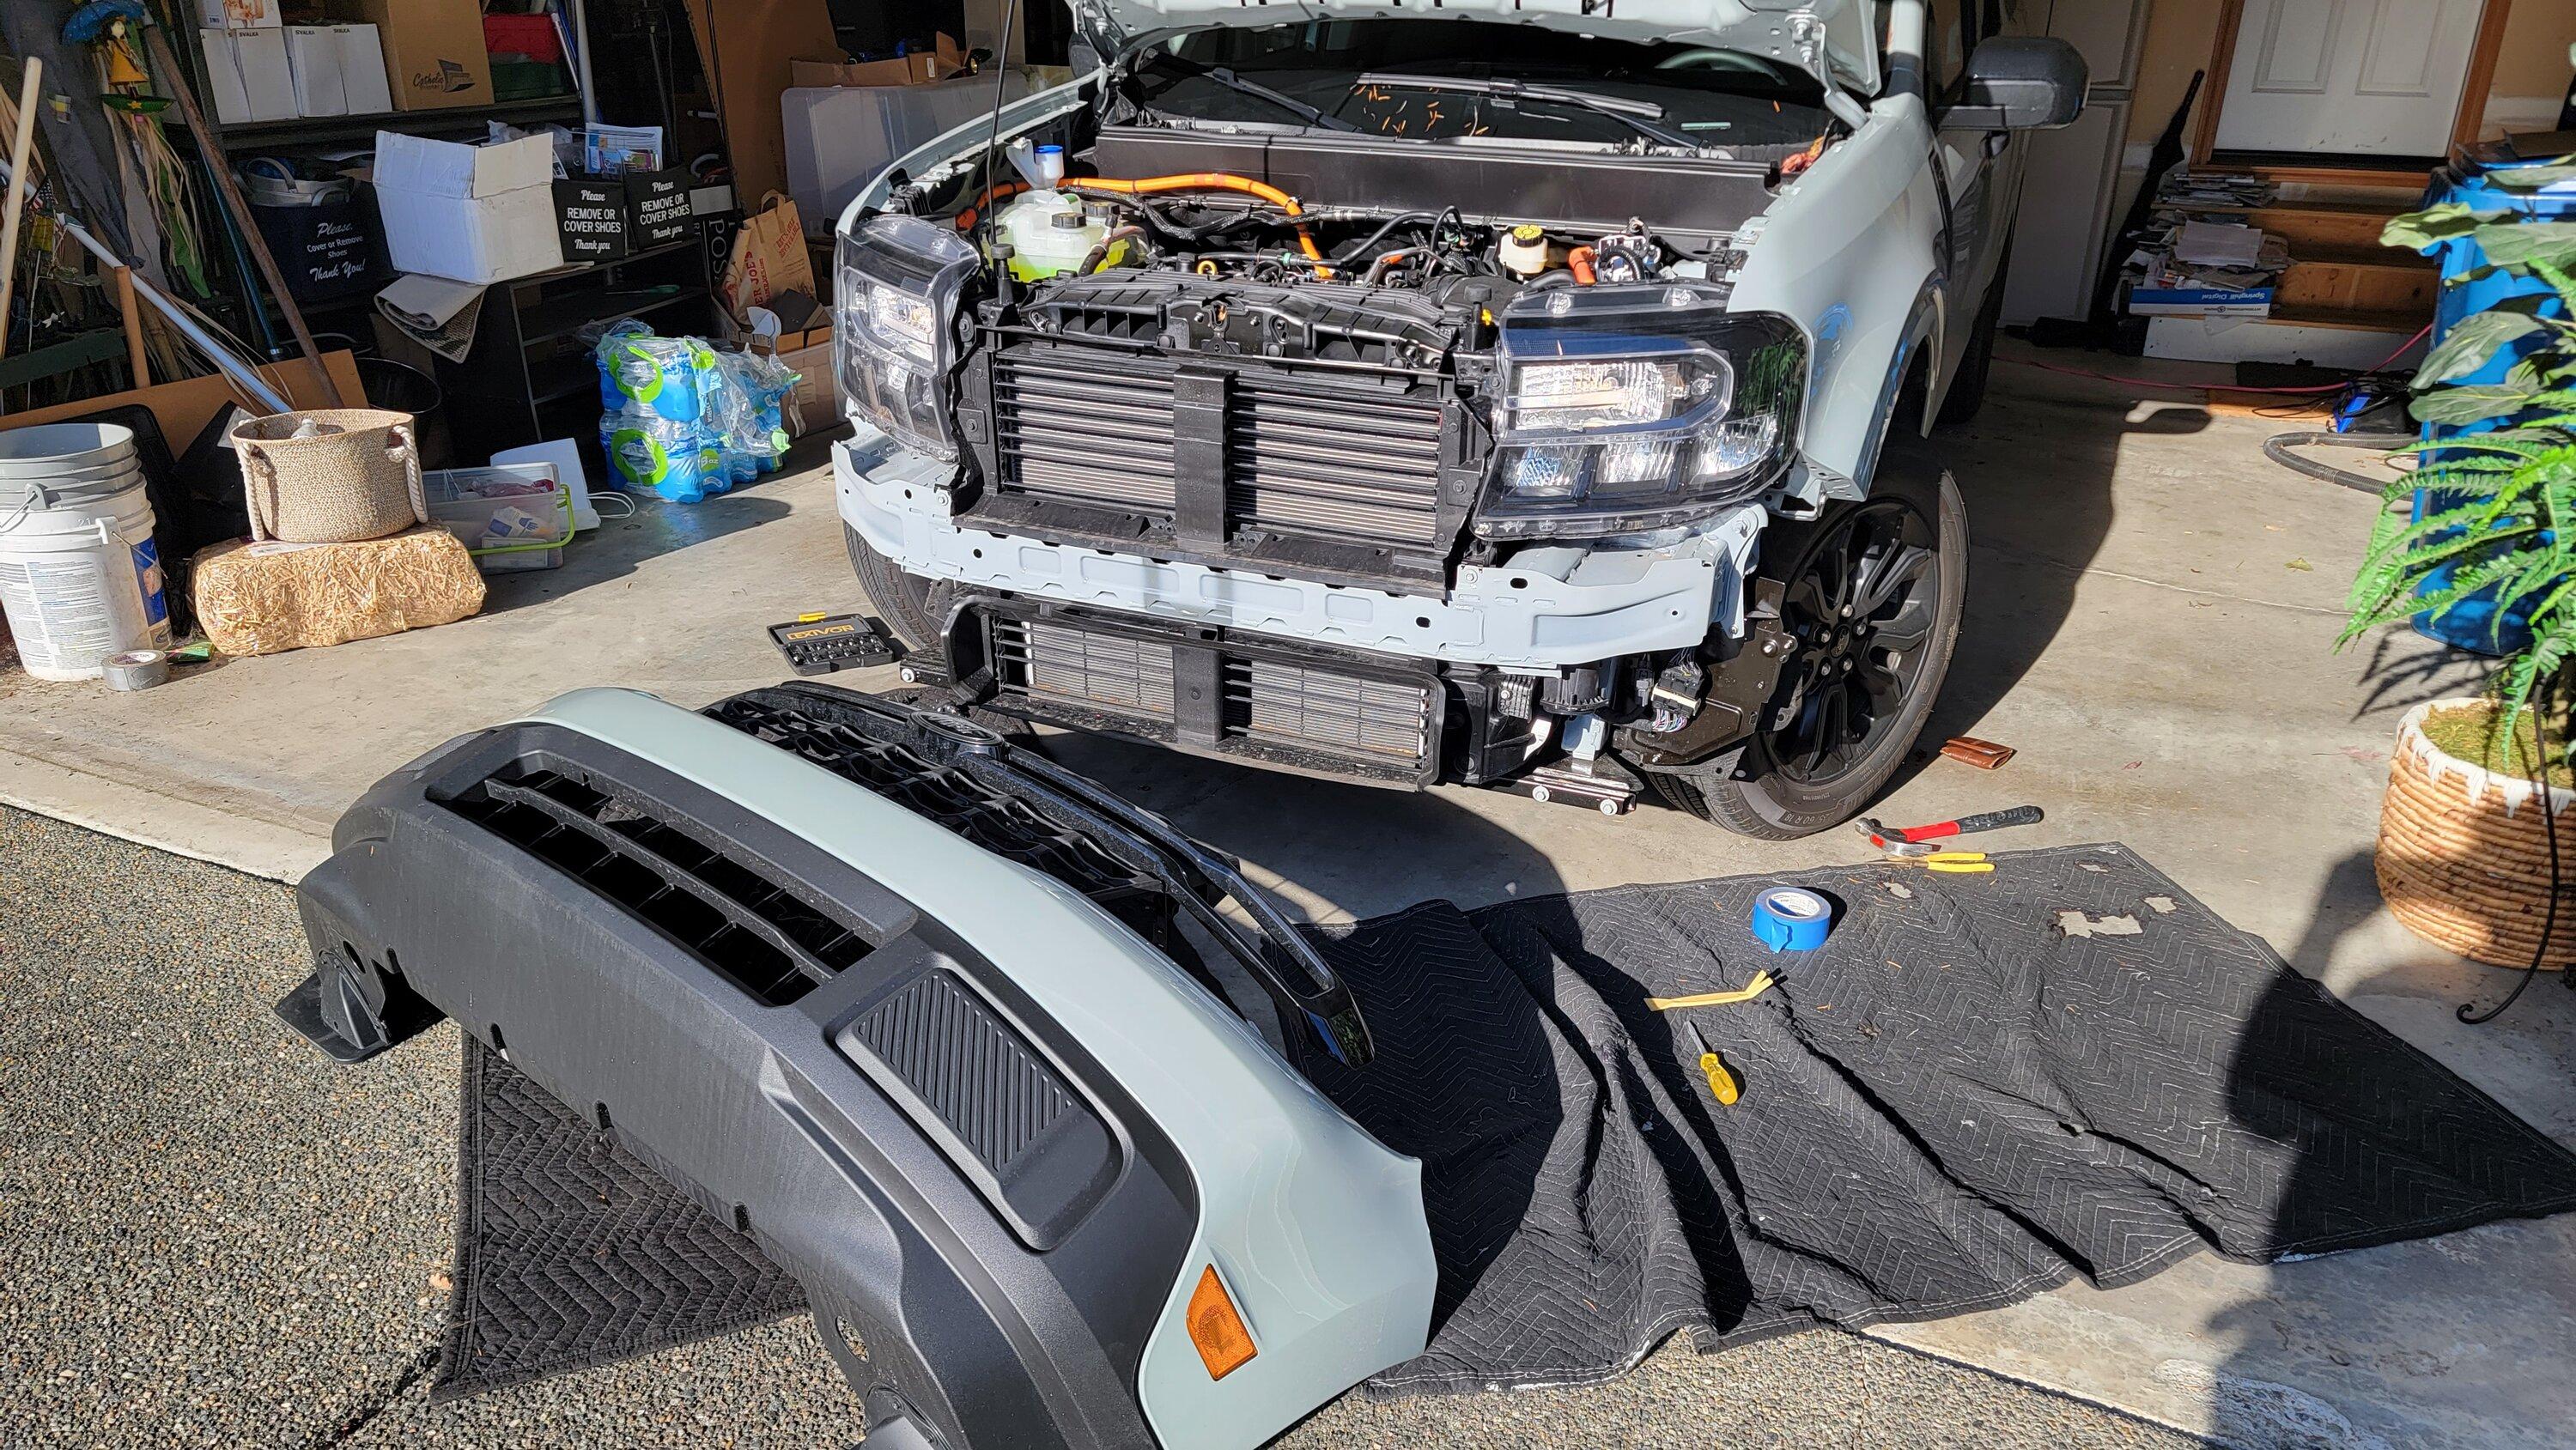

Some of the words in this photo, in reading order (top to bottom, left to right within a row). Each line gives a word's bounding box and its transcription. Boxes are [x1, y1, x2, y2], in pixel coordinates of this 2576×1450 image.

[652, 181, 675, 193] Please
[580, 190, 606, 202] Please
[641, 196, 674, 212] REMOVE
[675, 193, 685, 205] OR
[567, 207, 602, 220] REMOVE
[604, 209, 616, 220] OR
[640, 211, 667, 226] COVER
[668, 203, 690, 220] SHOES
[563, 221, 593, 233] COVER
[594, 221, 621, 234] SHOES
[652, 228, 671, 240] Thank
[671, 225, 683, 239] you
[307, 243, 326, 252] Cover
[336, 236, 364, 246] Remove
[574, 239, 598, 250] Thank
[597, 241, 611, 254] you
[709, 218, 728, 281] POS
[327, 249, 348, 258] Shoes
[309, 264, 339, 282] Thank
[2201, 292, 2227, 300] Digital
[2229, 292, 2266, 300] Springhill
[786, 624, 855, 640] LEXIVON
[1784, 813, 1795, 822] 18
[1795, 816, 1804, 824] R
